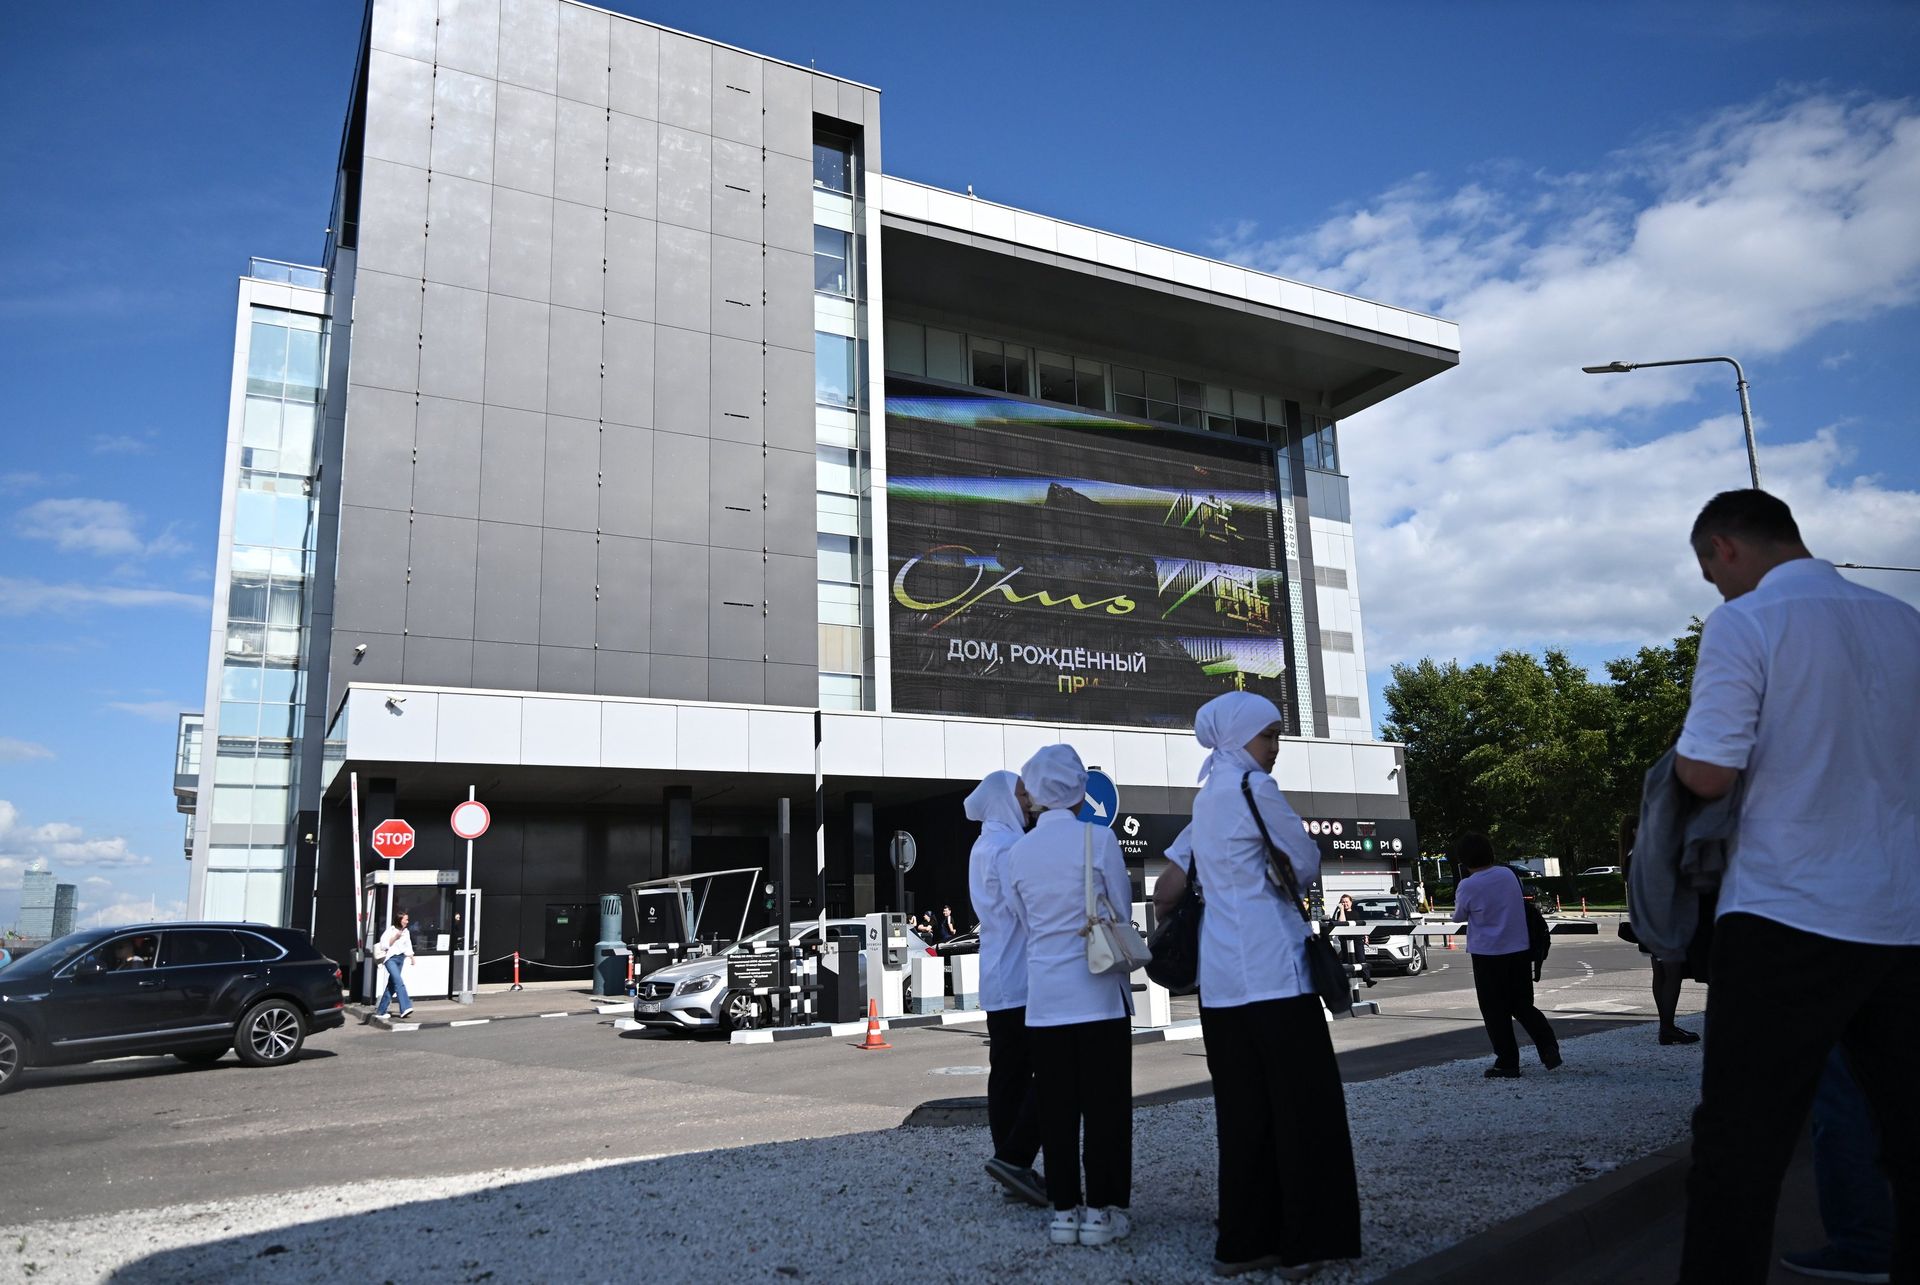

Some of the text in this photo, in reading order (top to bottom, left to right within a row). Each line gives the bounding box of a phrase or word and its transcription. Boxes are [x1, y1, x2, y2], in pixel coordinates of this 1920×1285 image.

[947, 638, 1147, 673] ДОМ, РОЖДЁННЫЙ
[375, 832, 412, 845] STOP
[1333, 840, 1362, 850] ВЪЕЗД
